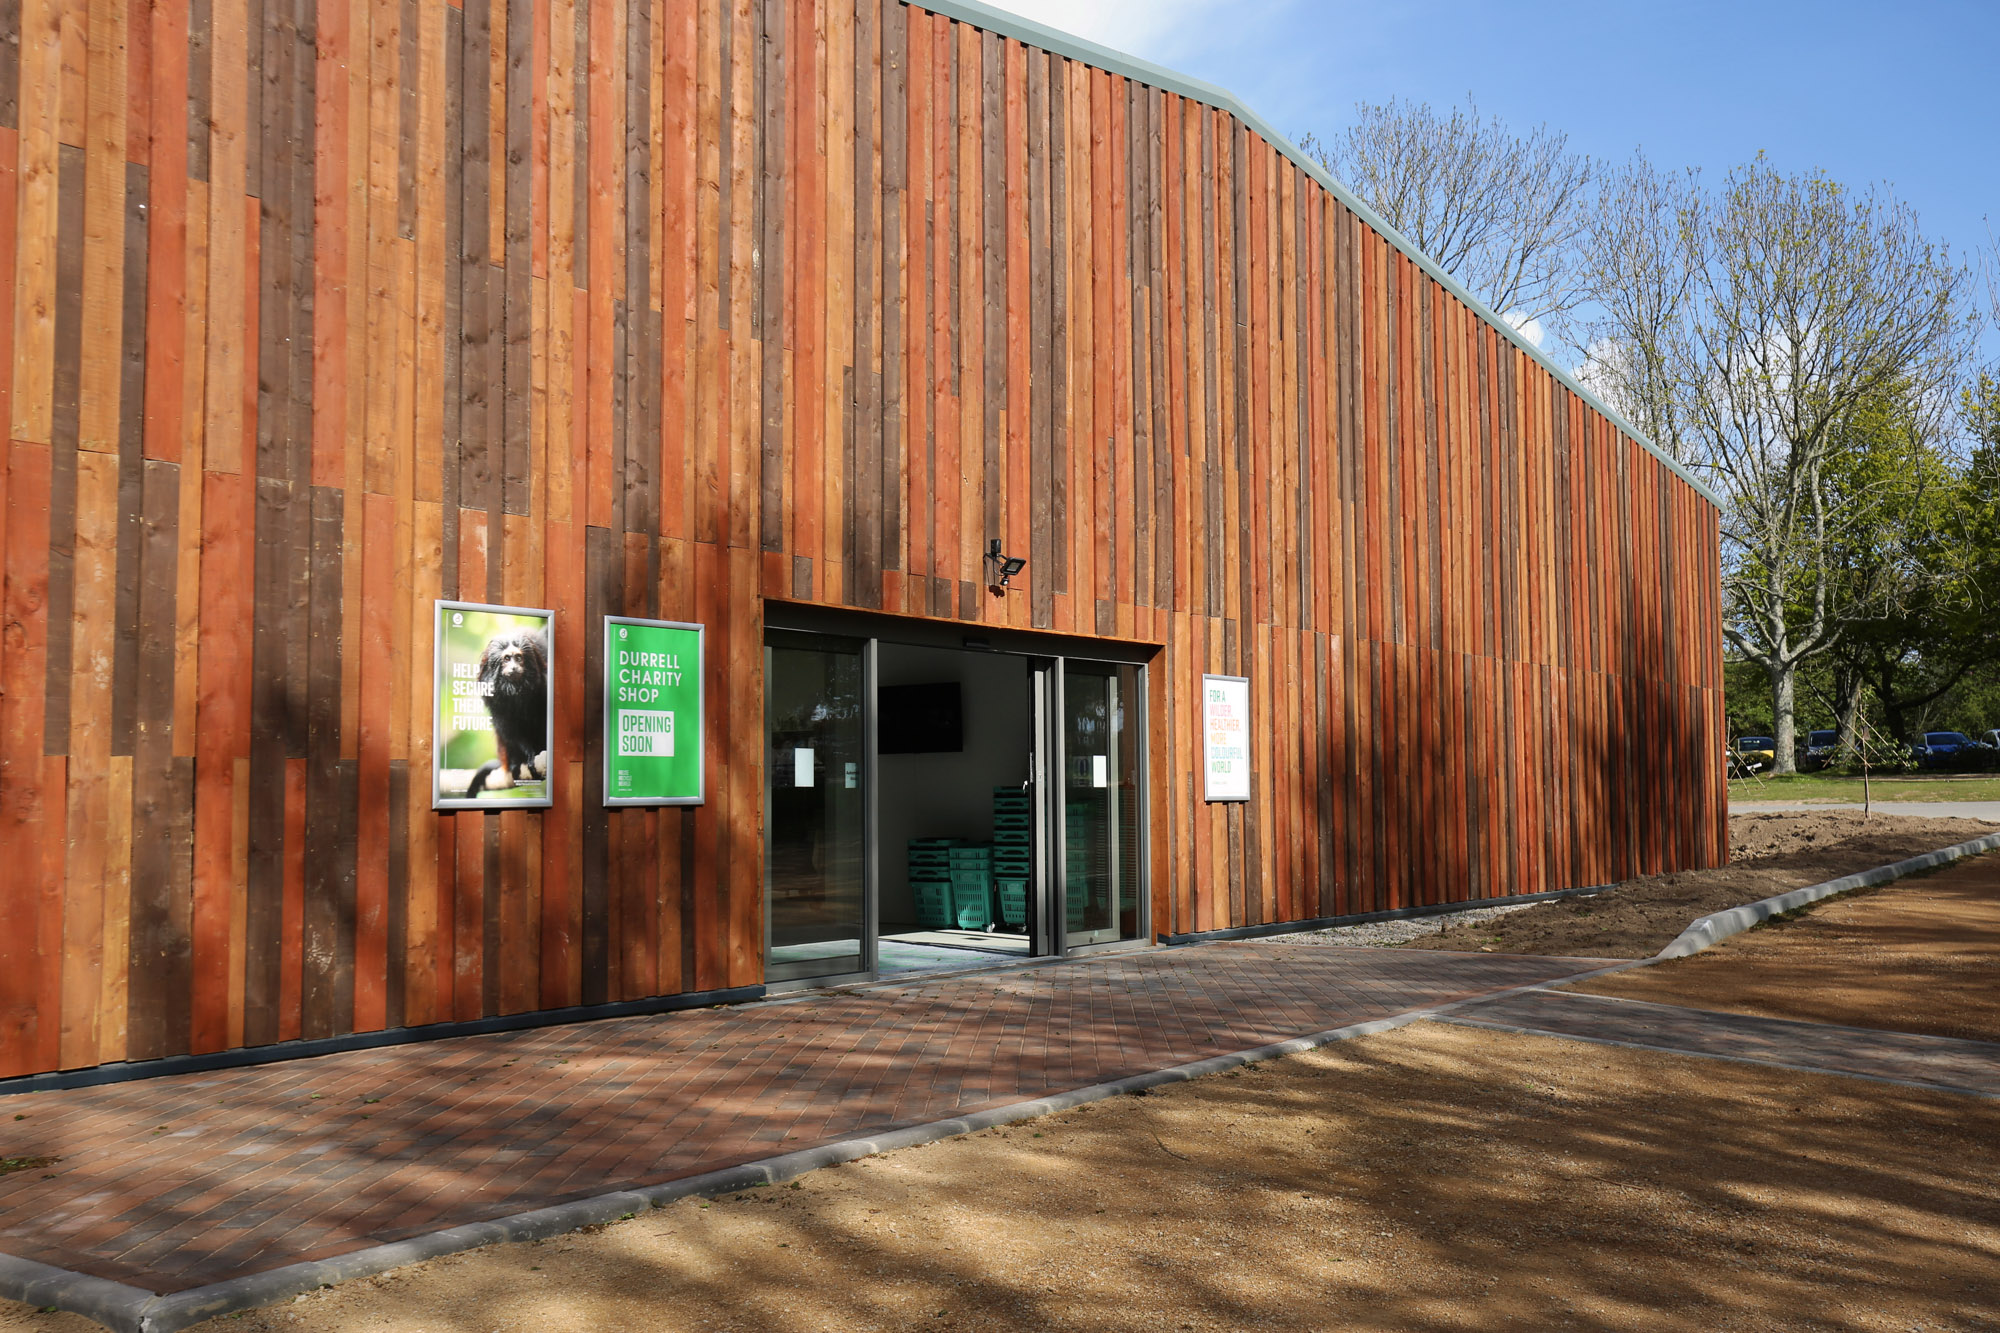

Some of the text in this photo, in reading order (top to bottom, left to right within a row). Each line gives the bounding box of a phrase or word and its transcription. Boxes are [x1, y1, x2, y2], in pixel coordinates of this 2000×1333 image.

[619, 651, 680, 669] DURRELL
[453, 663, 480, 678] HELP
[619, 669, 682, 687] CHARITY
[452, 681, 495, 697] SECURE
[619, 687, 659, 703] SHOP
[1210, 690, 1226, 702] FOR A
[452, 698, 485, 713] THEIR
[452, 715, 493, 731] FUTURE
[622, 714, 671, 733] OPENING
[622, 735, 653, 753] SOON
[1211, 732, 1227, 745] MORE
[1211, 747, 1243, 760] COLOURFUL
[1211, 761, 1232, 774] WORLD
